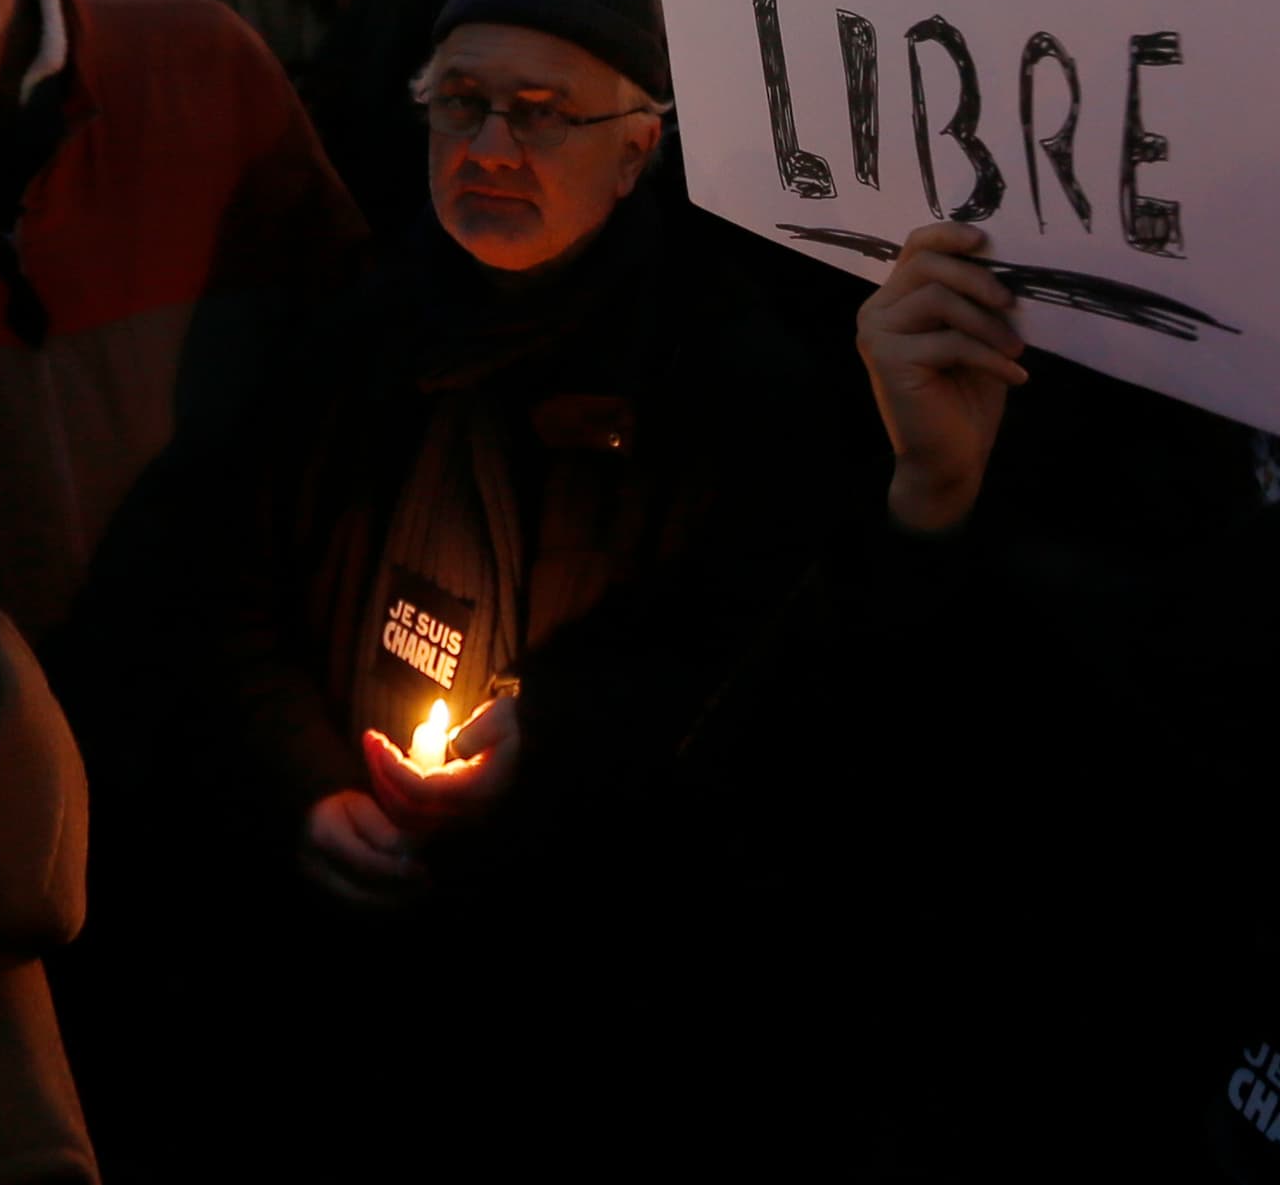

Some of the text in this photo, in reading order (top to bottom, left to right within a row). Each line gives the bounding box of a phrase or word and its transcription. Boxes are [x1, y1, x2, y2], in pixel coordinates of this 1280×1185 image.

[383, 620, 458, 690] CHARLIE
[389, 599, 463, 656] JE SUIS
